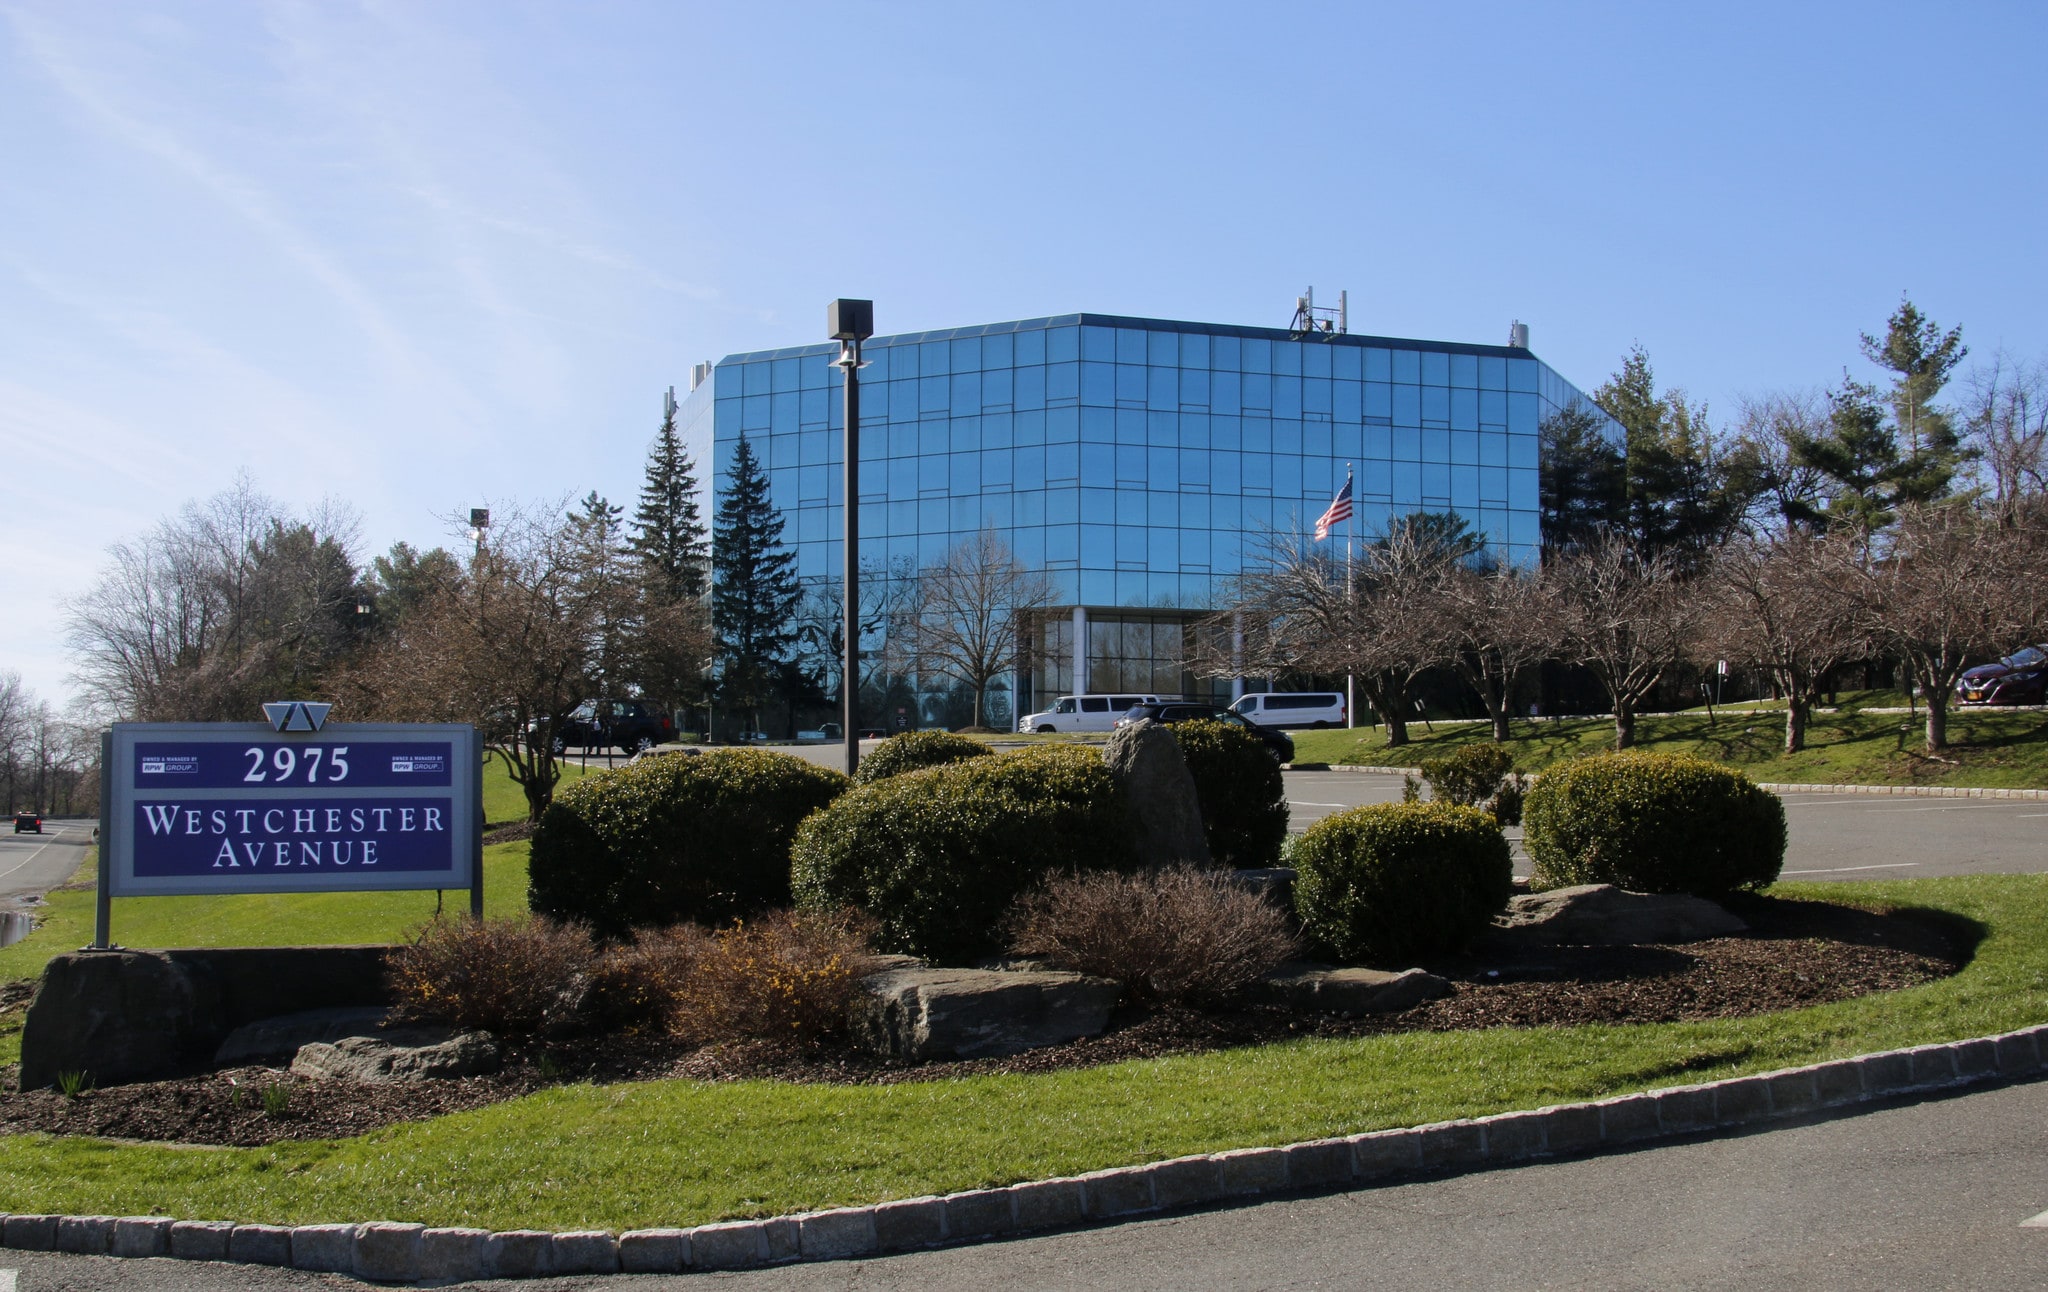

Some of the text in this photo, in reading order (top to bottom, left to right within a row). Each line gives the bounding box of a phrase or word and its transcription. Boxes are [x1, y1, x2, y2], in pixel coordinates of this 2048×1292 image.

[244, 747, 349, 782] 2975
[142, 805, 444, 836] WESTCHESTER
[212, 838, 378, 868] AVENUE
